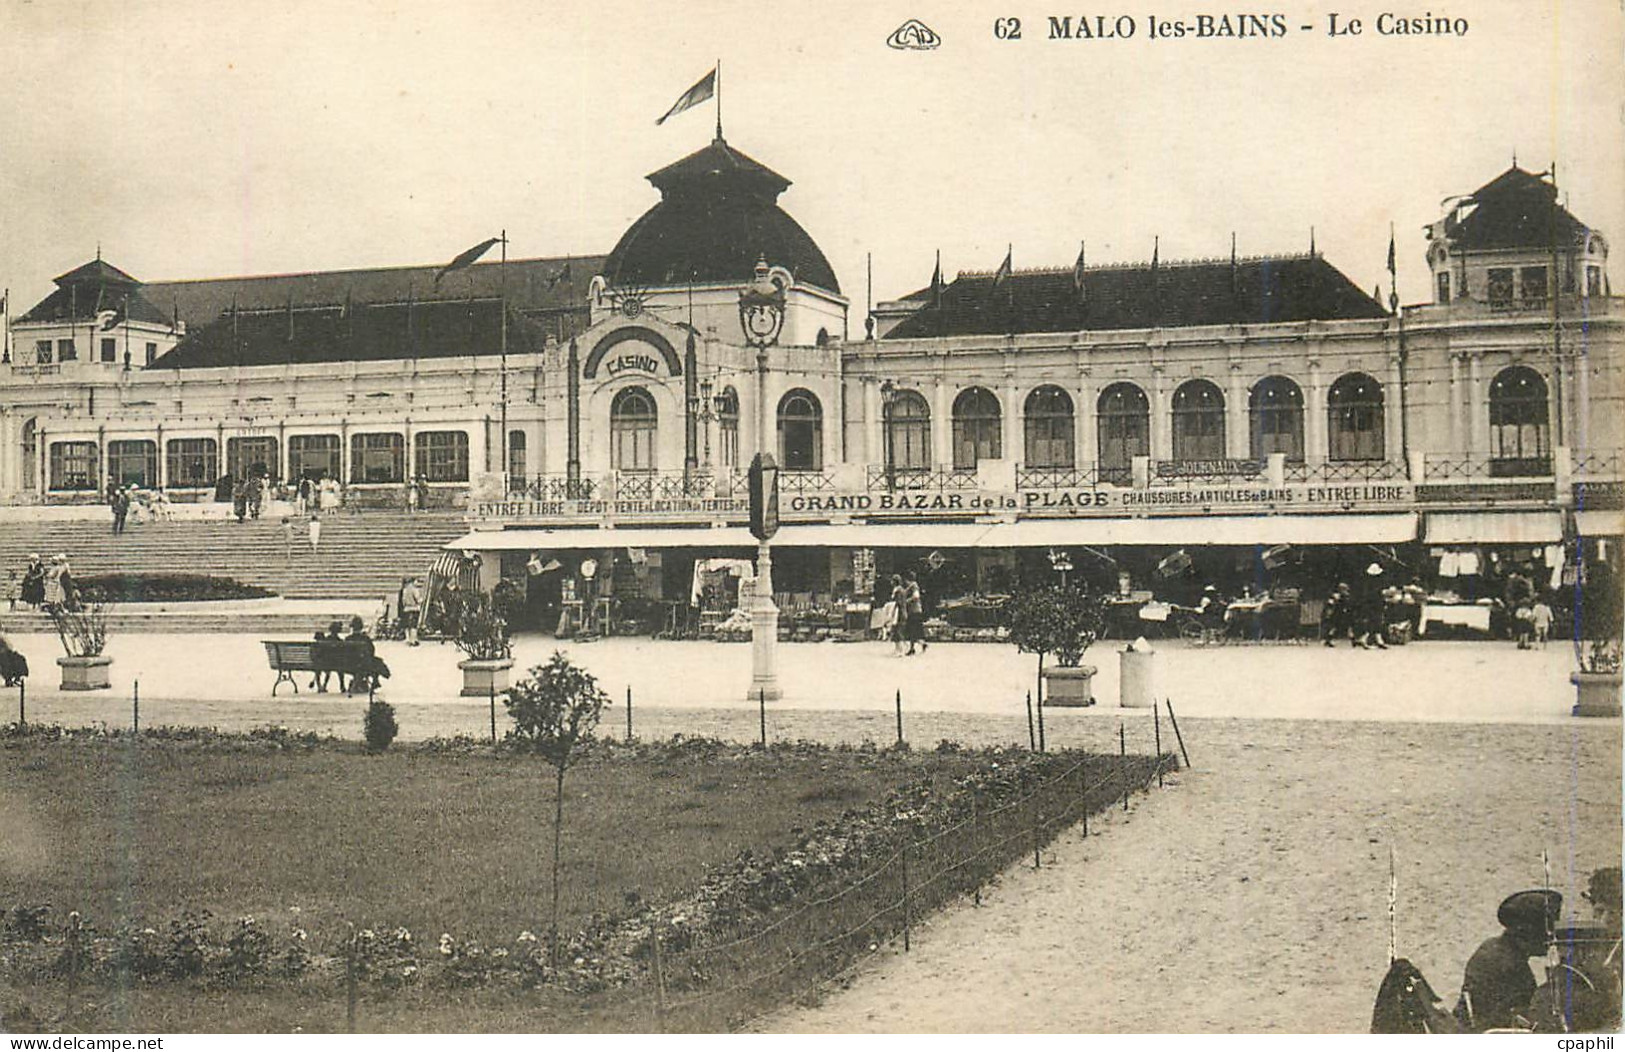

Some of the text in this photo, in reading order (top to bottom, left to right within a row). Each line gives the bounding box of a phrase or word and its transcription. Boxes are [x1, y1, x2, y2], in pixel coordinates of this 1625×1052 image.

[606, 355, 658, 376] CASINO
[1122, 491, 1194, 505] CHAUSSURES
[1199, 489, 1252, 502] ARTICLES
[1364, 485, 1402, 500] LIBRE
[529, 500, 565, 516] LIBRE
[791, 492, 1109, 511] GRAND BAZAR de la PLAGE
